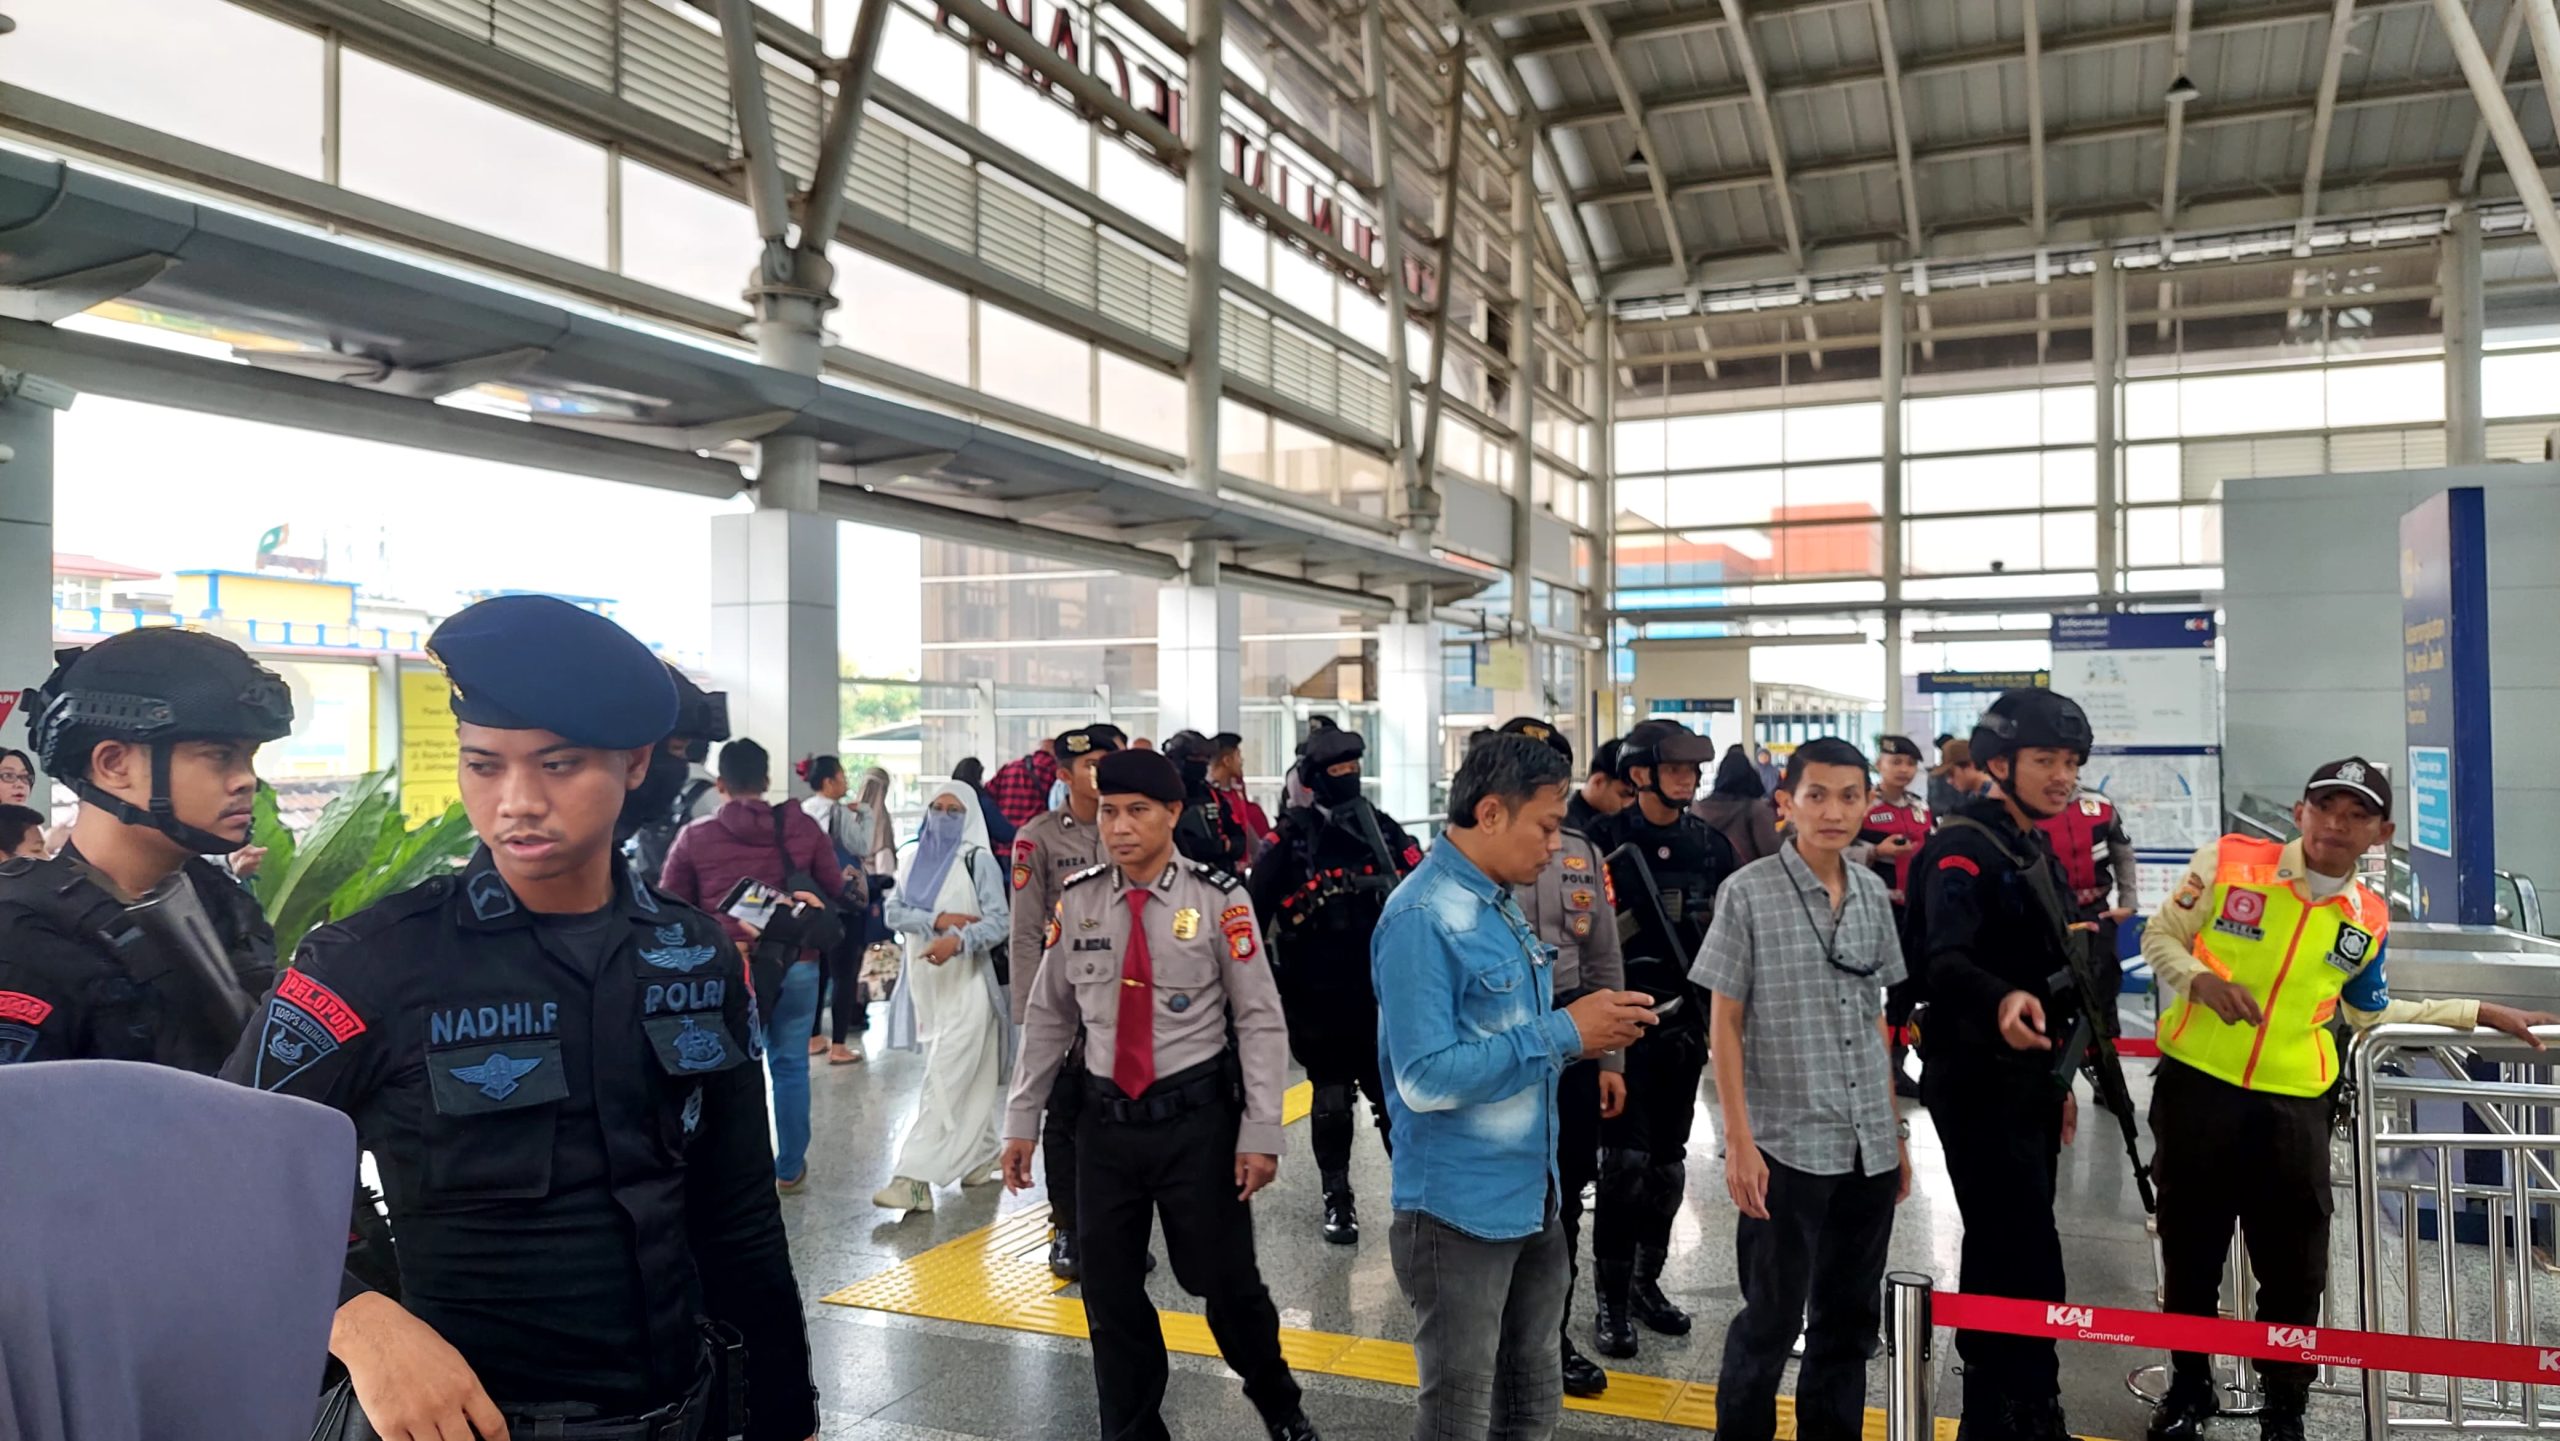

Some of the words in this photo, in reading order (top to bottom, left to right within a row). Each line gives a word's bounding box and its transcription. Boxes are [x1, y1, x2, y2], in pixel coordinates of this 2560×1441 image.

[1562, 873, 1594, 885] POLRI
[284, 974, 357, 1035] PELOPOR
[274, 1005, 301, 1027] KORPS
[298, 1022, 333, 1051] BRIMOB
[2046, 1304, 2094, 1328] KAI
[2077, 1328, 2136, 1343] Commuter
[2266, 1325, 2318, 1350] KAI
[2300, 1350, 2363, 1365] Commuter
